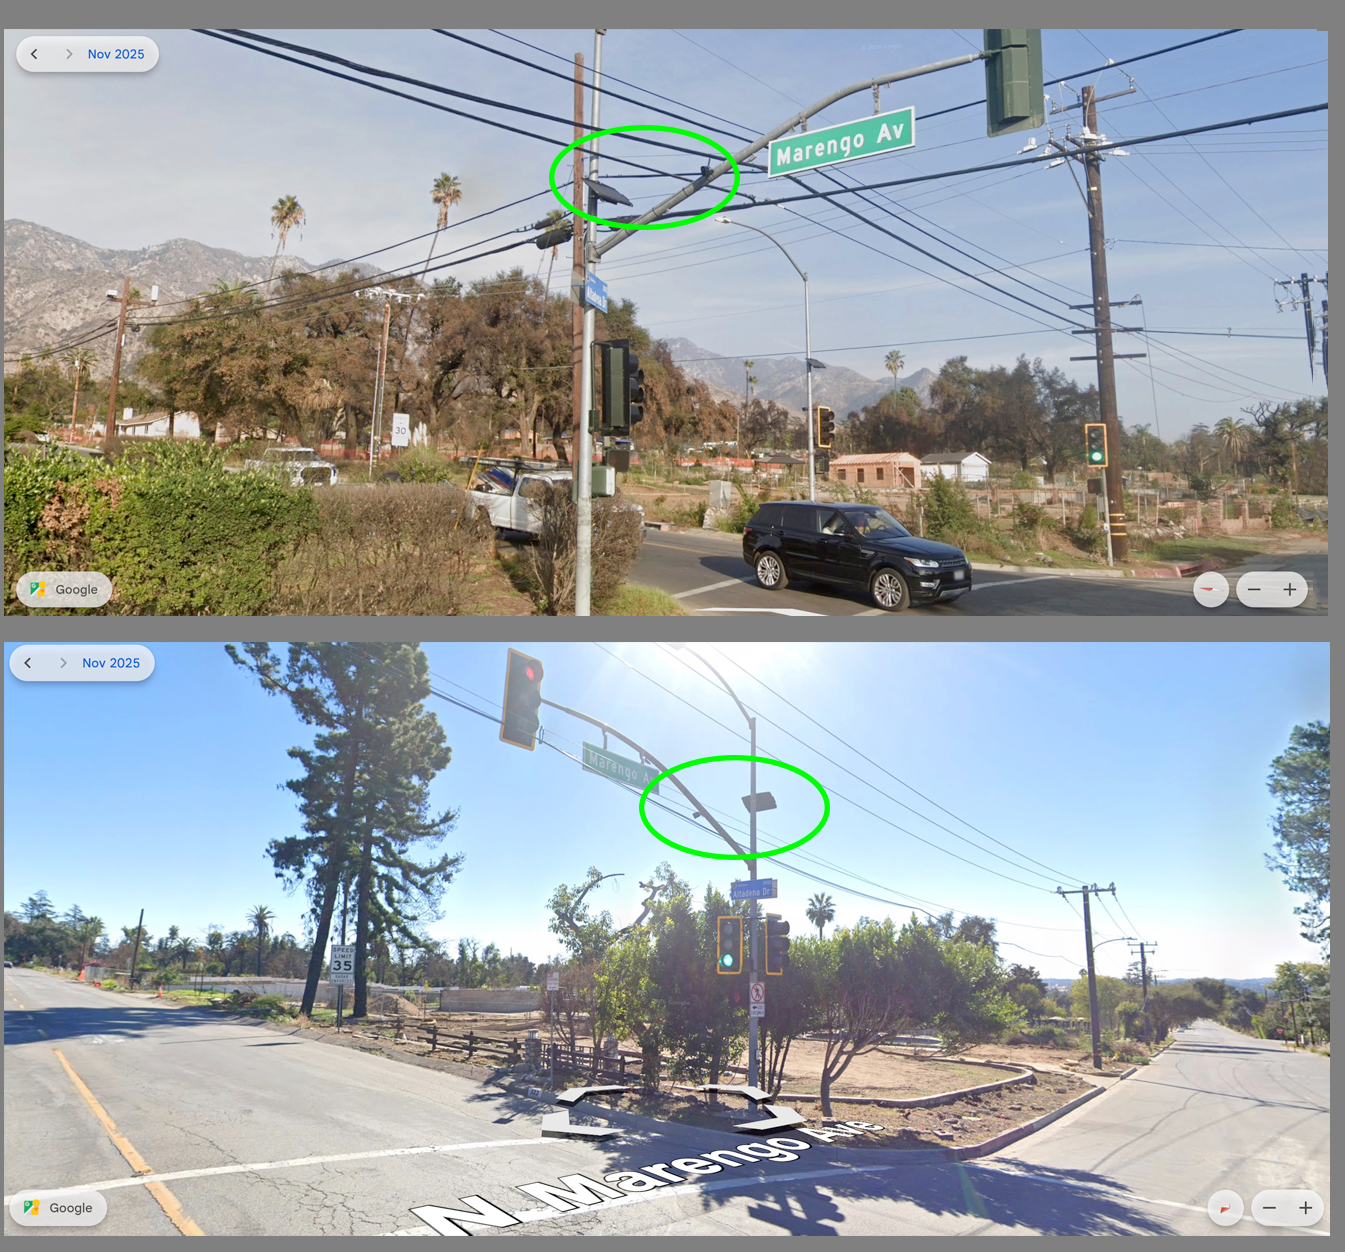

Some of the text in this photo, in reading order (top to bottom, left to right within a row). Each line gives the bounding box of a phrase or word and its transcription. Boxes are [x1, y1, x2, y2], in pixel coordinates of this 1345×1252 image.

[777, 123, 904, 166] Marengo Av
[395, 427, 407, 435] 30
[589, 751, 638, 782] Marengo
[733, 887, 771, 898] Altadena Dr
[333, 960, 352, 971] 35
